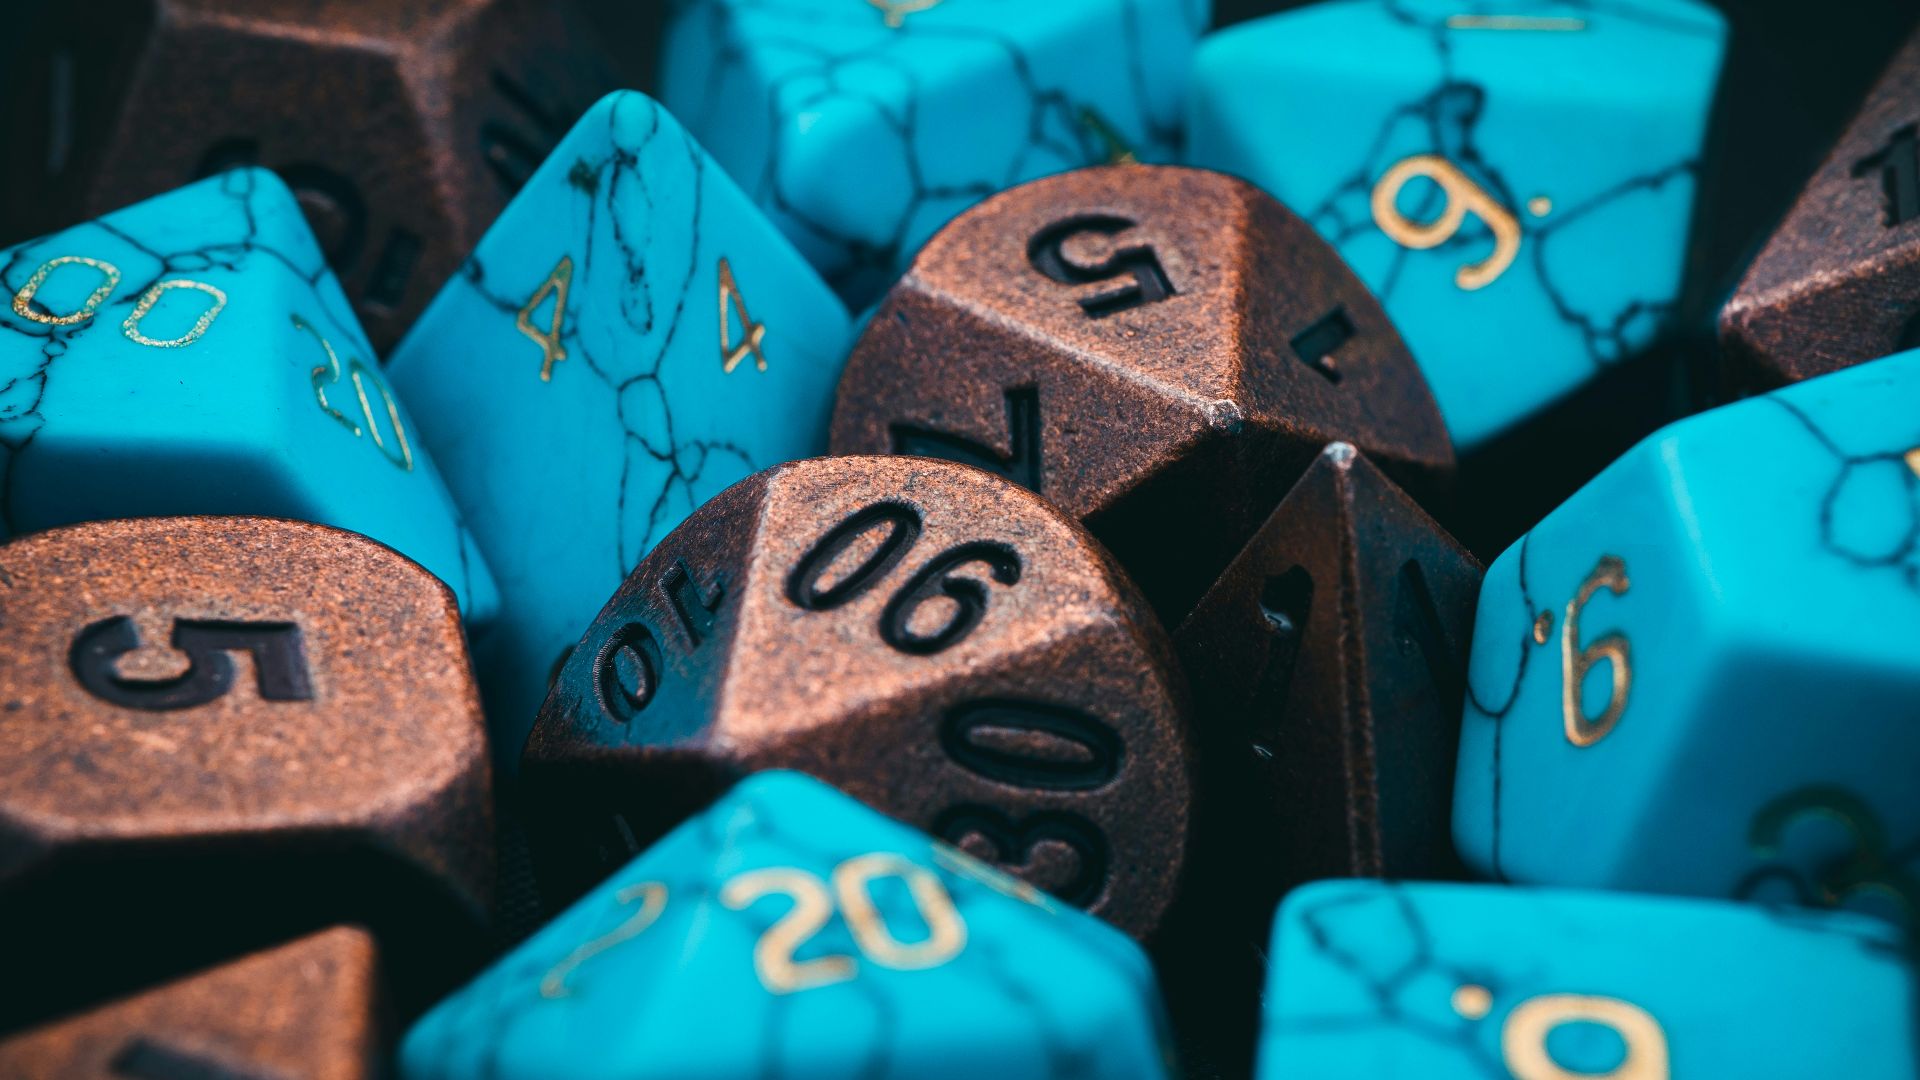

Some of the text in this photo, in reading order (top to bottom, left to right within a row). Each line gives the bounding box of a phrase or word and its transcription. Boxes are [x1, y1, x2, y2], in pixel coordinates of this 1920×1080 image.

[11, 255, 229, 348] 00
[515, 254, 571, 383] 4
[718, 257, 767, 374] 4
[1027, 213, 1178, 318] 5
[70, 614, 314, 712] 5
[717, 849, 970, 997] 20
